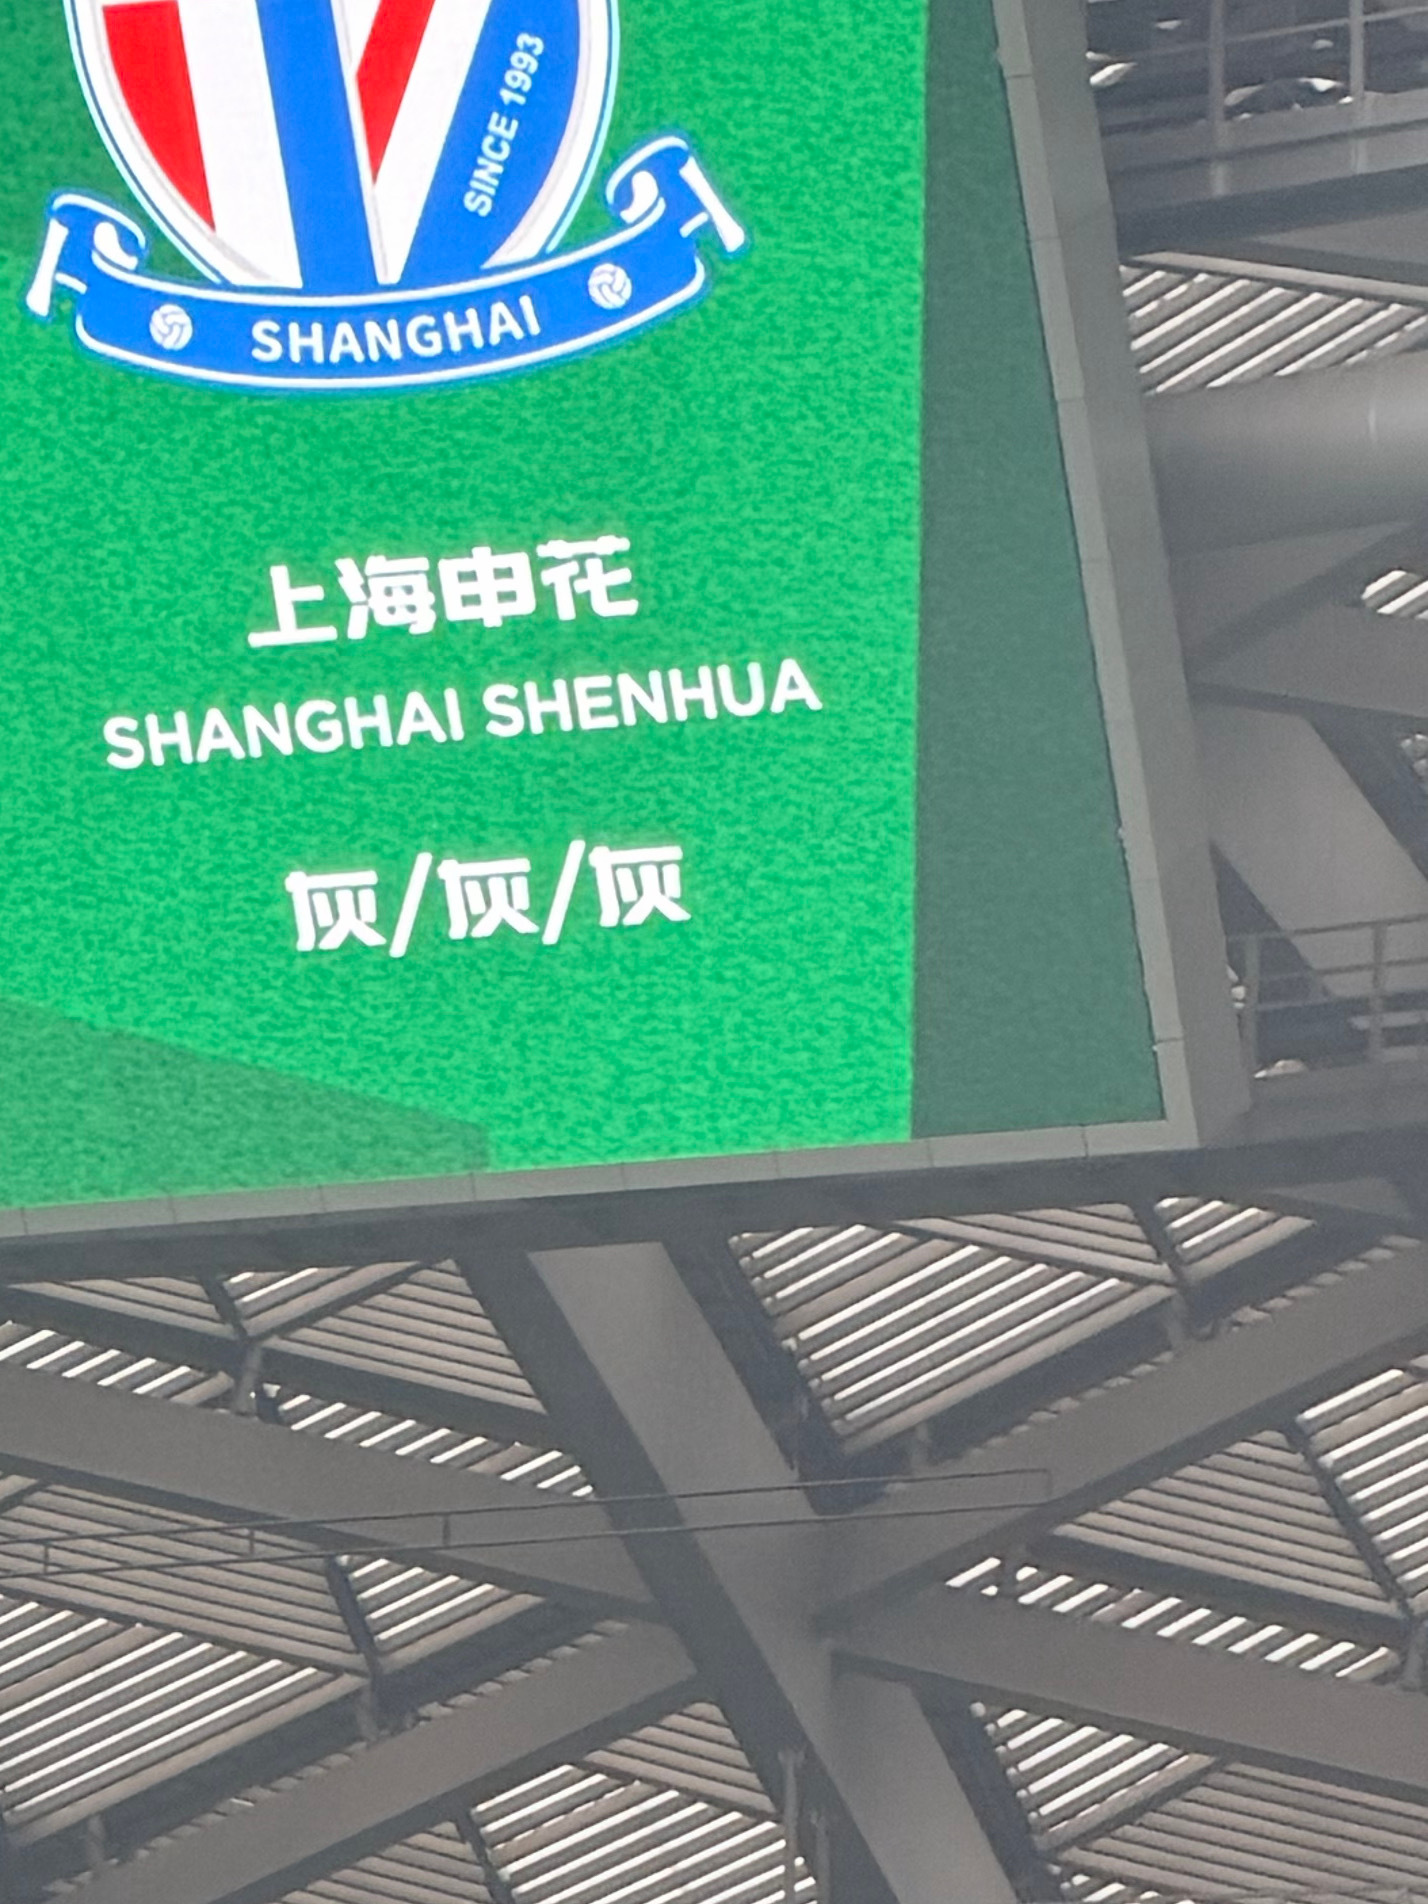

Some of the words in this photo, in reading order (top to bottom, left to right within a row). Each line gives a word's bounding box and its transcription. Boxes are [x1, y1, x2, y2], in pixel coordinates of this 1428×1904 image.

[463, 111, 519, 217] SINCE
[499, 32, 544, 106] 1993
[250, 295, 542, 364] SHANGHAI
[246, 533, 640, 649] 上海申花
[101, 686, 466, 770] SHANGHAI
[480, 656, 824, 738] SHENHUA
